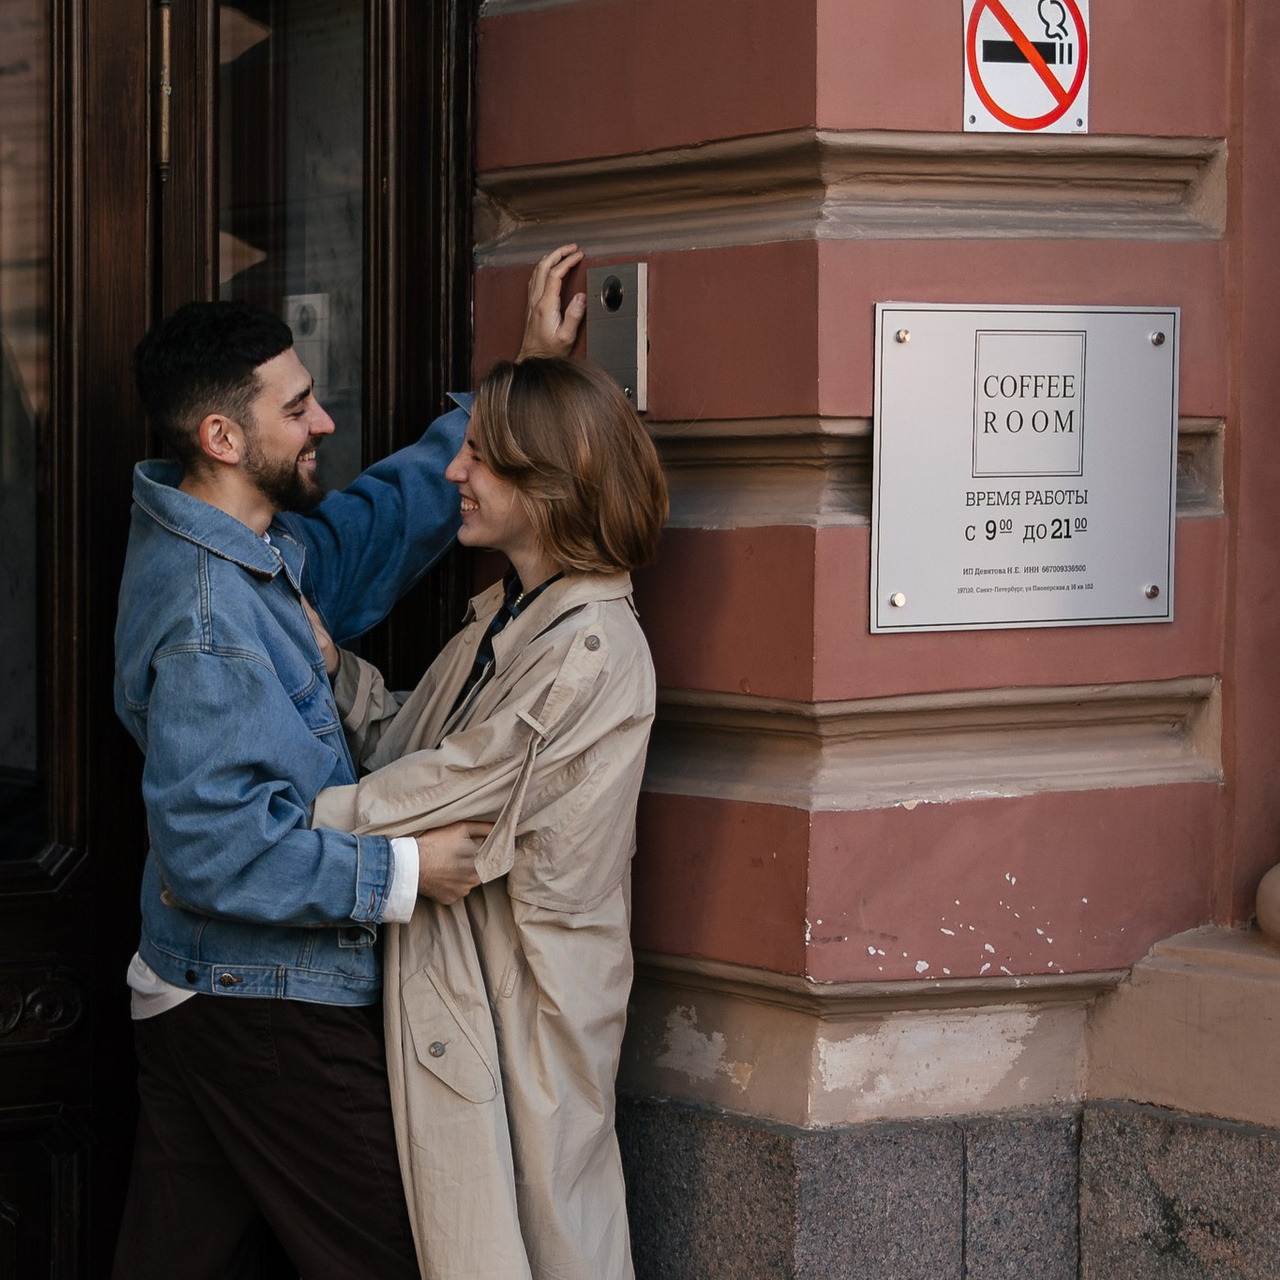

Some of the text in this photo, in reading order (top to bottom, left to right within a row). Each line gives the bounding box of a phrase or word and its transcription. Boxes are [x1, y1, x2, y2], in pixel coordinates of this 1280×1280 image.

[982, 374, 1076, 399] COFFEE
[982, 409, 1075, 434] ROOM
[965, 489, 1089, 507] ВРЕМЯ РАБОТЫ
[1023, 565, 1039, 573] ИНН
